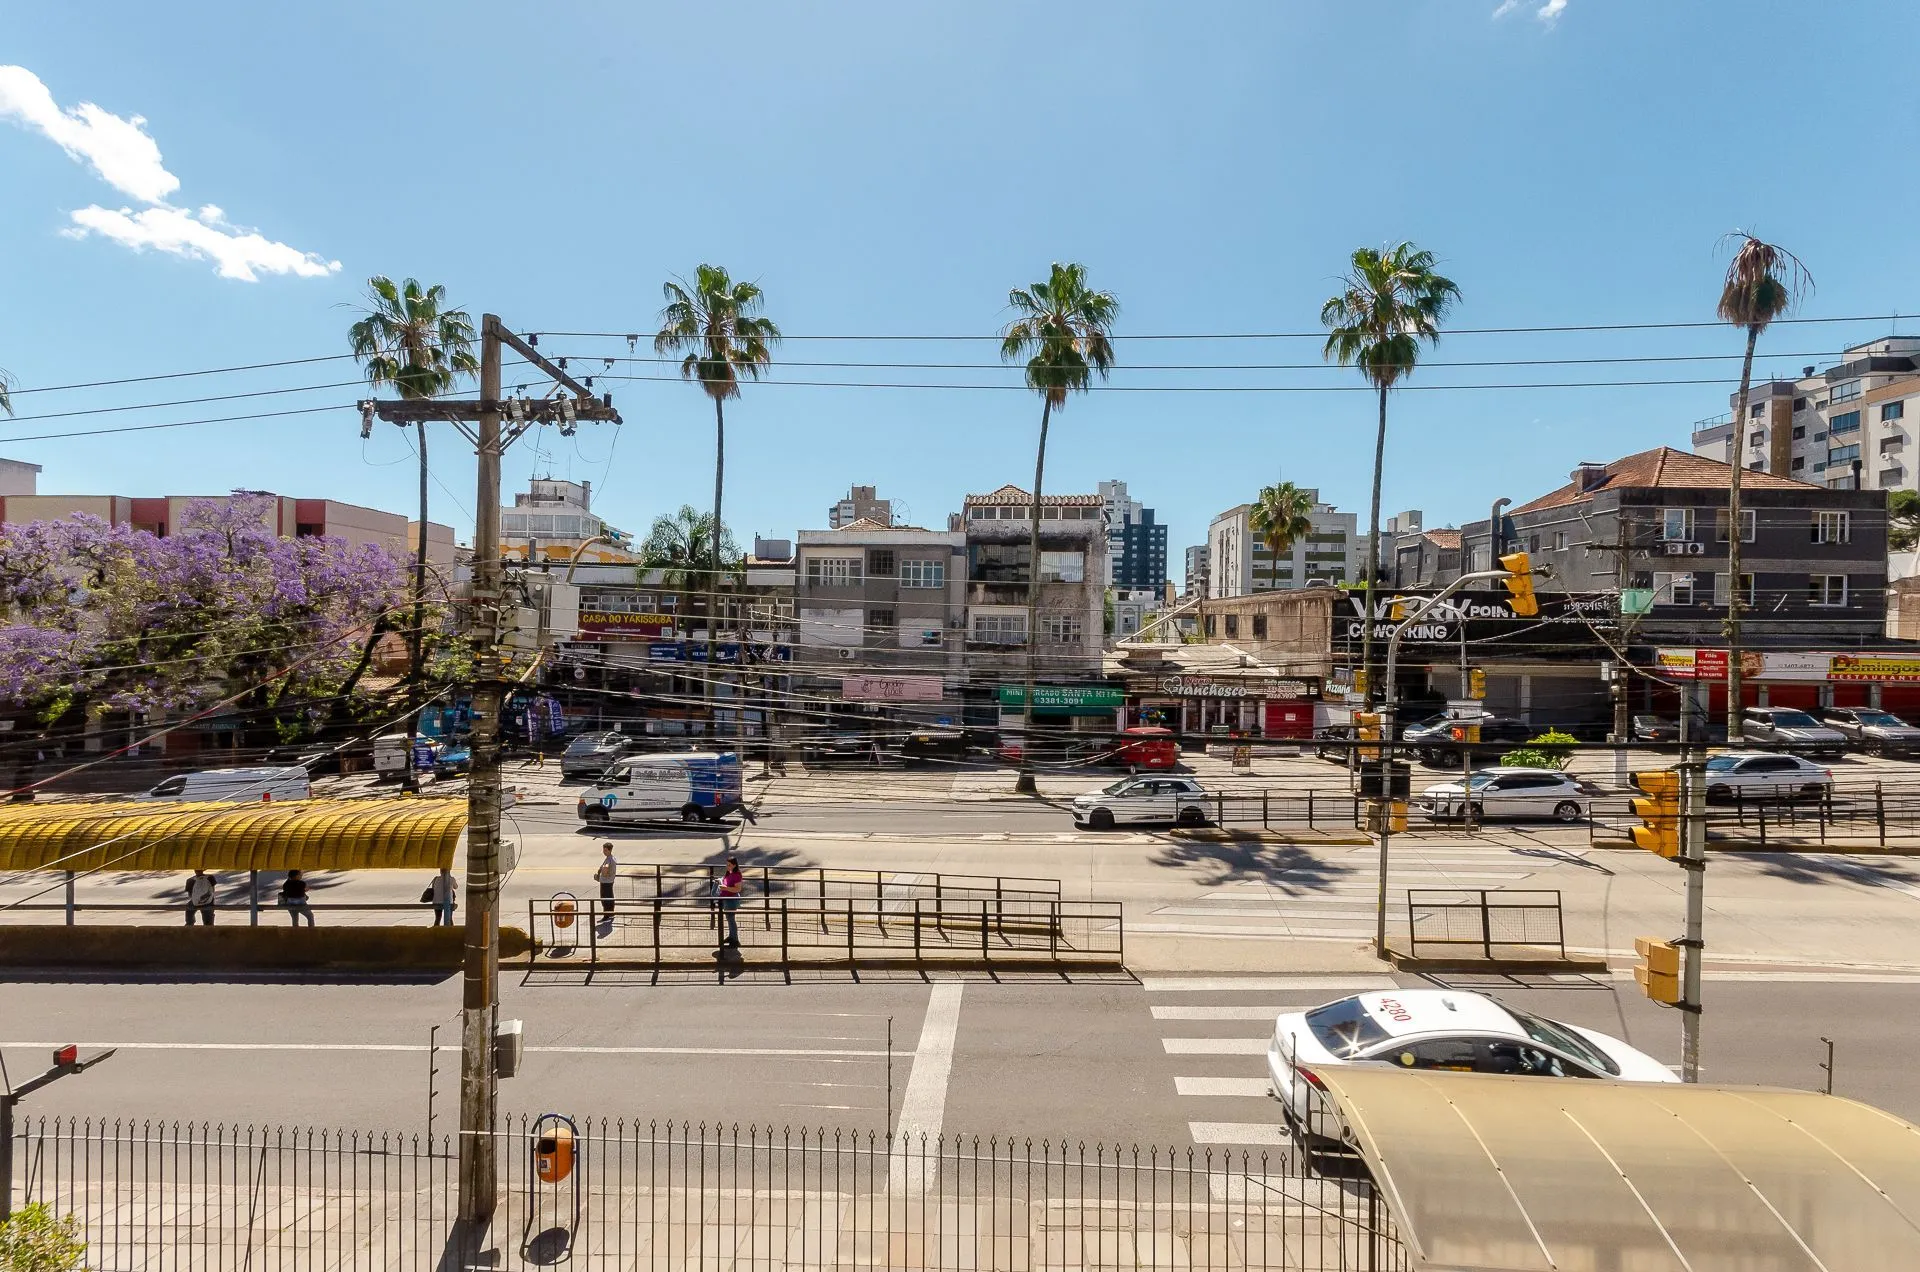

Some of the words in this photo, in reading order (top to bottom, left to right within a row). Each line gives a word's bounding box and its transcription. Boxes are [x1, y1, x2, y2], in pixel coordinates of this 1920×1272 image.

[583, 614, 607, 623] CASA
[609, 614, 621, 623] DO
[623, 615, 673, 624] YAKISSOBA
[1350, 623, 1447, 639] CWOKING
[1061, 688, 1093, 697] SANTA
[1380, 998, 1412, 1021] 4280
